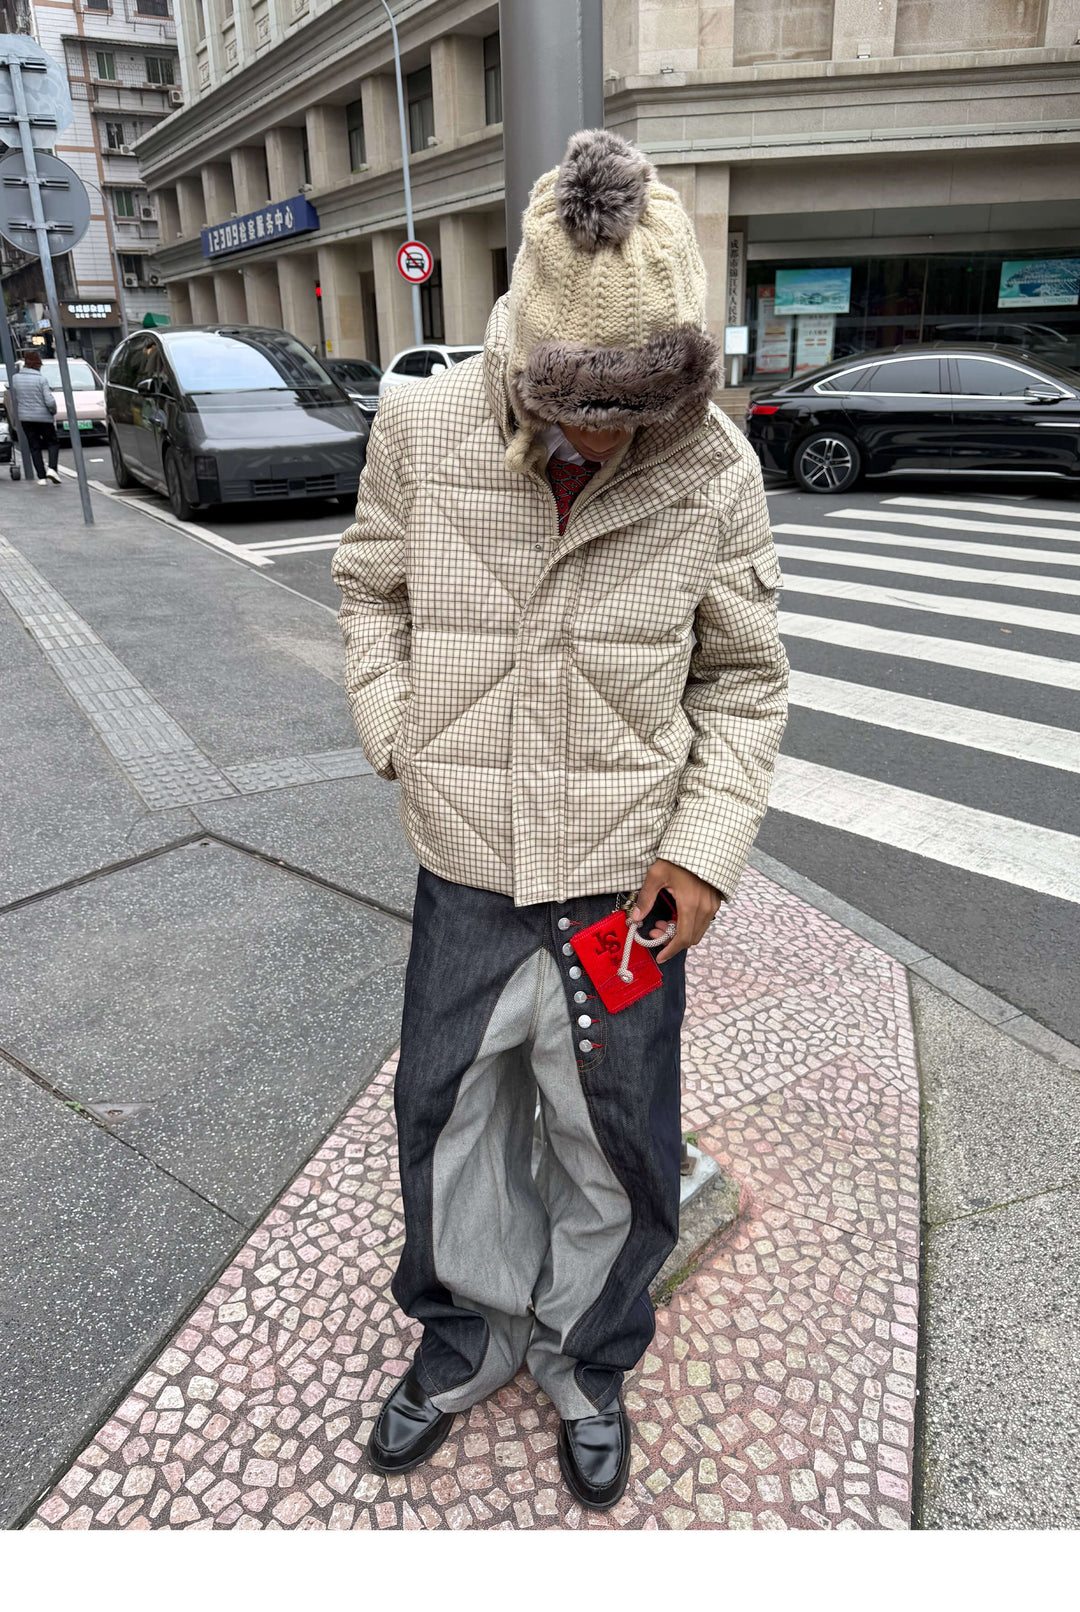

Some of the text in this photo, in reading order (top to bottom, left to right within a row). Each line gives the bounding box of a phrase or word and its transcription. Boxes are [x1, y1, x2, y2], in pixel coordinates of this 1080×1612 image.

[208, 205, 293, 253] 12309检察服务中心
[728, 239, 739, 325] 成都市锦江区人民检
